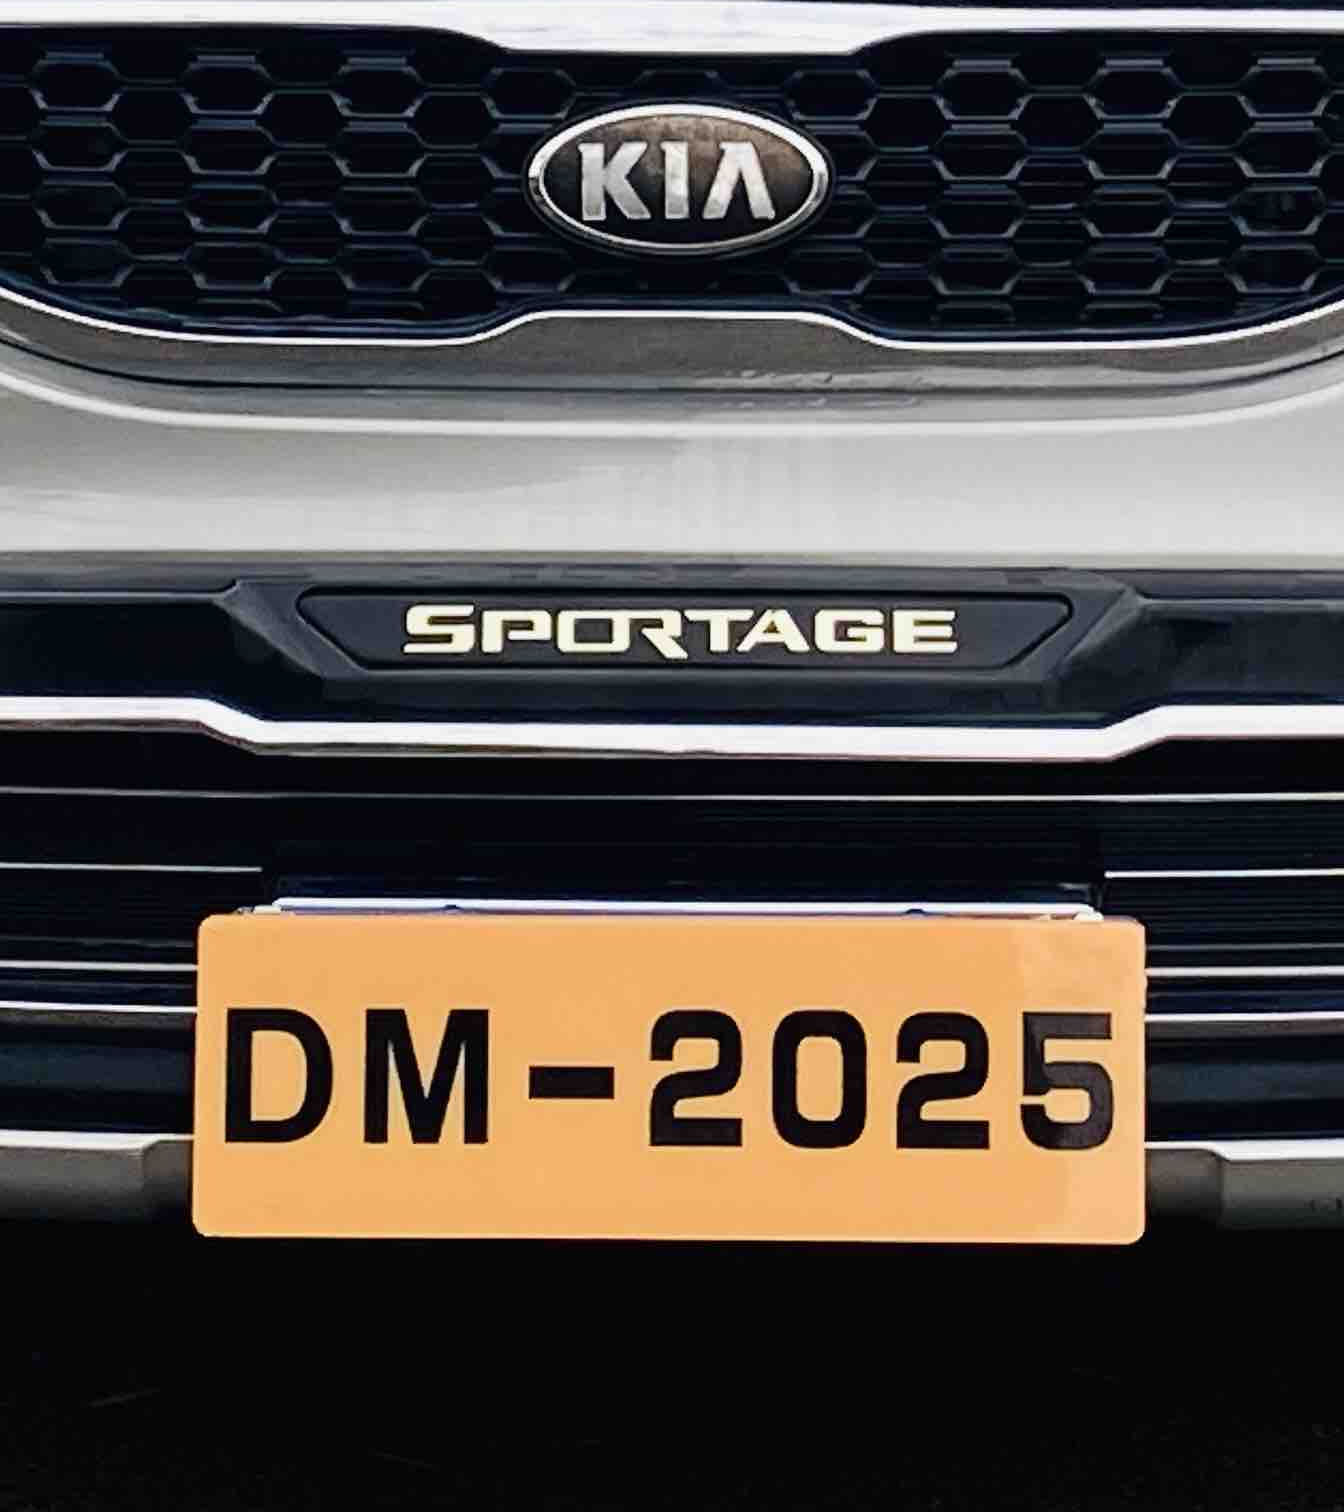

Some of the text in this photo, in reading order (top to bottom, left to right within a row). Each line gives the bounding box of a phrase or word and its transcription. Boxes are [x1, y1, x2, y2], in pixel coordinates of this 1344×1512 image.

[577, 141, 776, 222] KIA
[402, 604, 958, 660] SPORTAGE
[224, 1008, 1116, 1151] DM-2025
